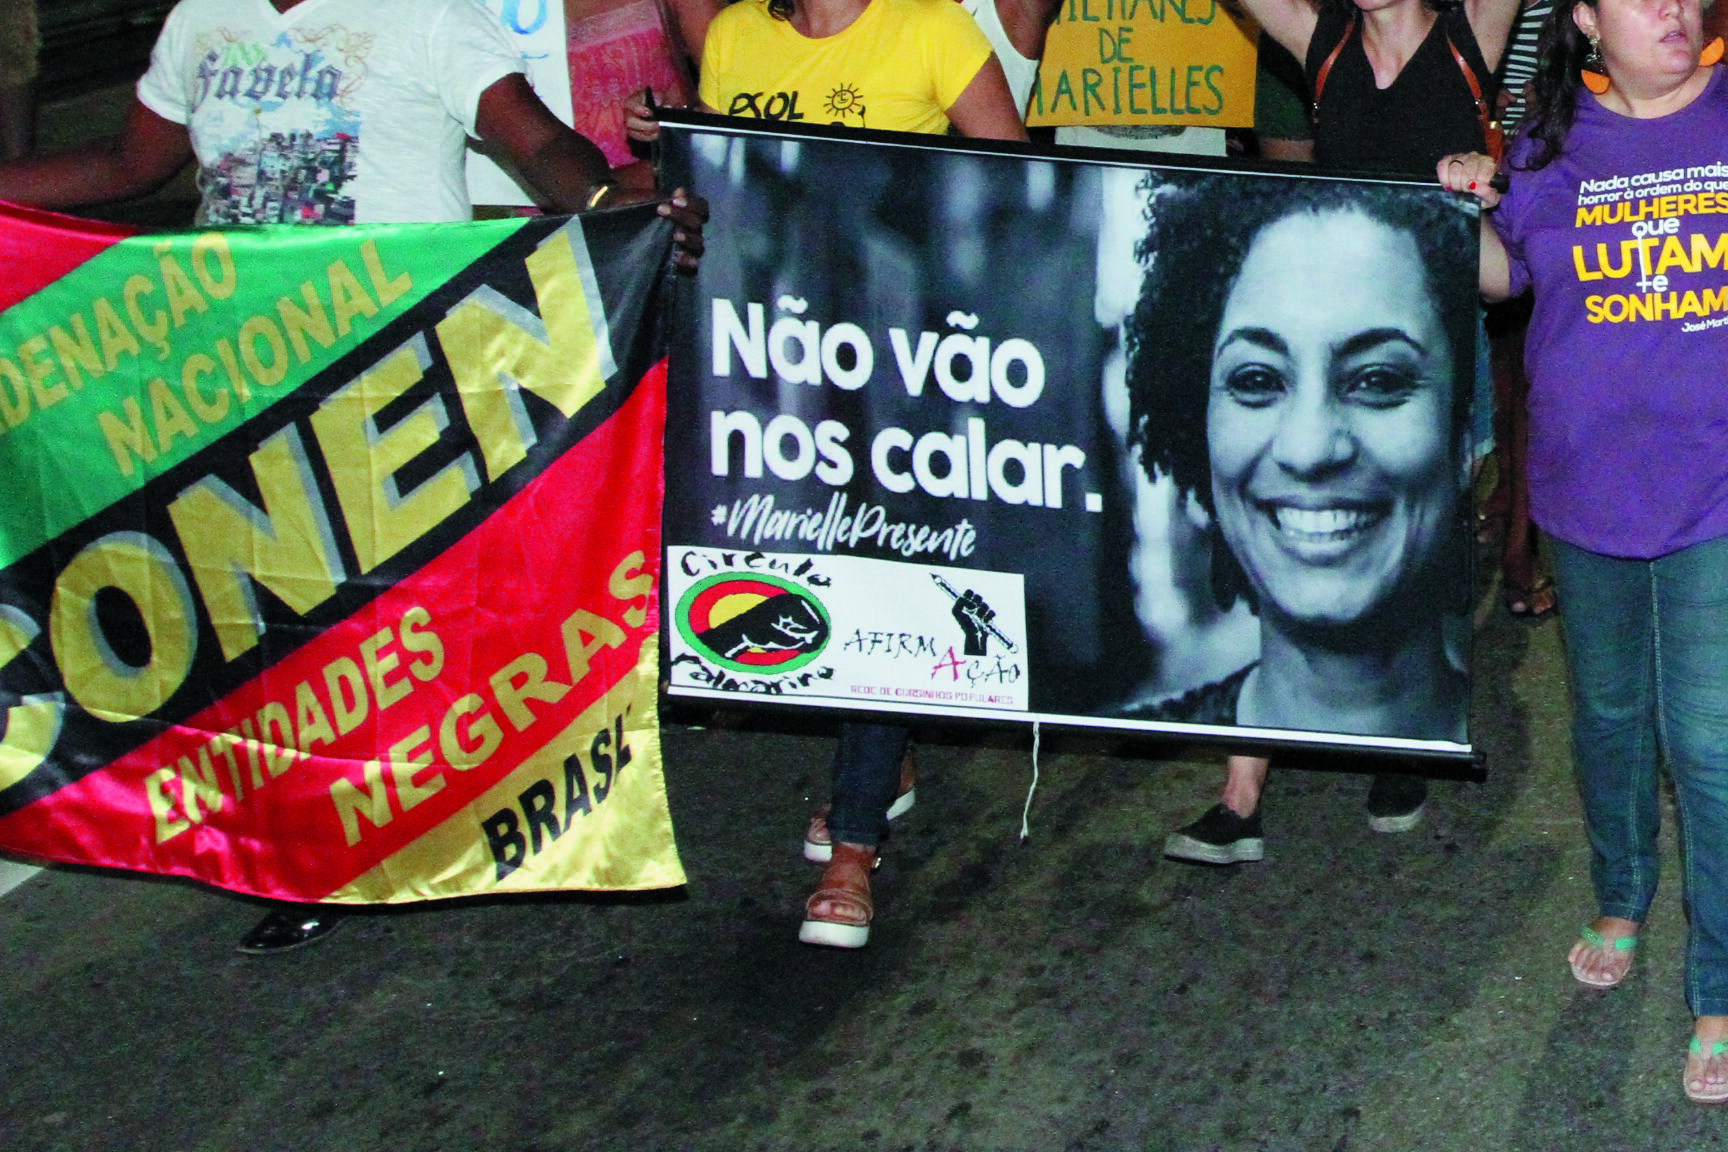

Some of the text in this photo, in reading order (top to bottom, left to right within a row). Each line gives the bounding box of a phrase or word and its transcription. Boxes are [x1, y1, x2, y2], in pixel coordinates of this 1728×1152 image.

[1098, 26, 1134, 65] DE
[728, 91, 804, 120] PSOL
[1577, 188, 1623, 206] horror
[1635, 181, 1681, 199] ordem
[1682, 179, 1703, 192] do
[1579, 175, 1630, 194] Nada
[1630, 168, 1684, 187] causa
[711, 294, 1046, 408] Não vão
[1681, 320, 1706, 333] José
[97, 239, 413, 478] NACIONAL
[711, 410, 1103, 513] nos calar.
[711, 491, 977, 561] #MariellePresente
[328, 549, 655, 848] NEGRAS
[894, 688, 953, 700] CURSINHOS
[144, 605, 446, 845] ENTIDADES
